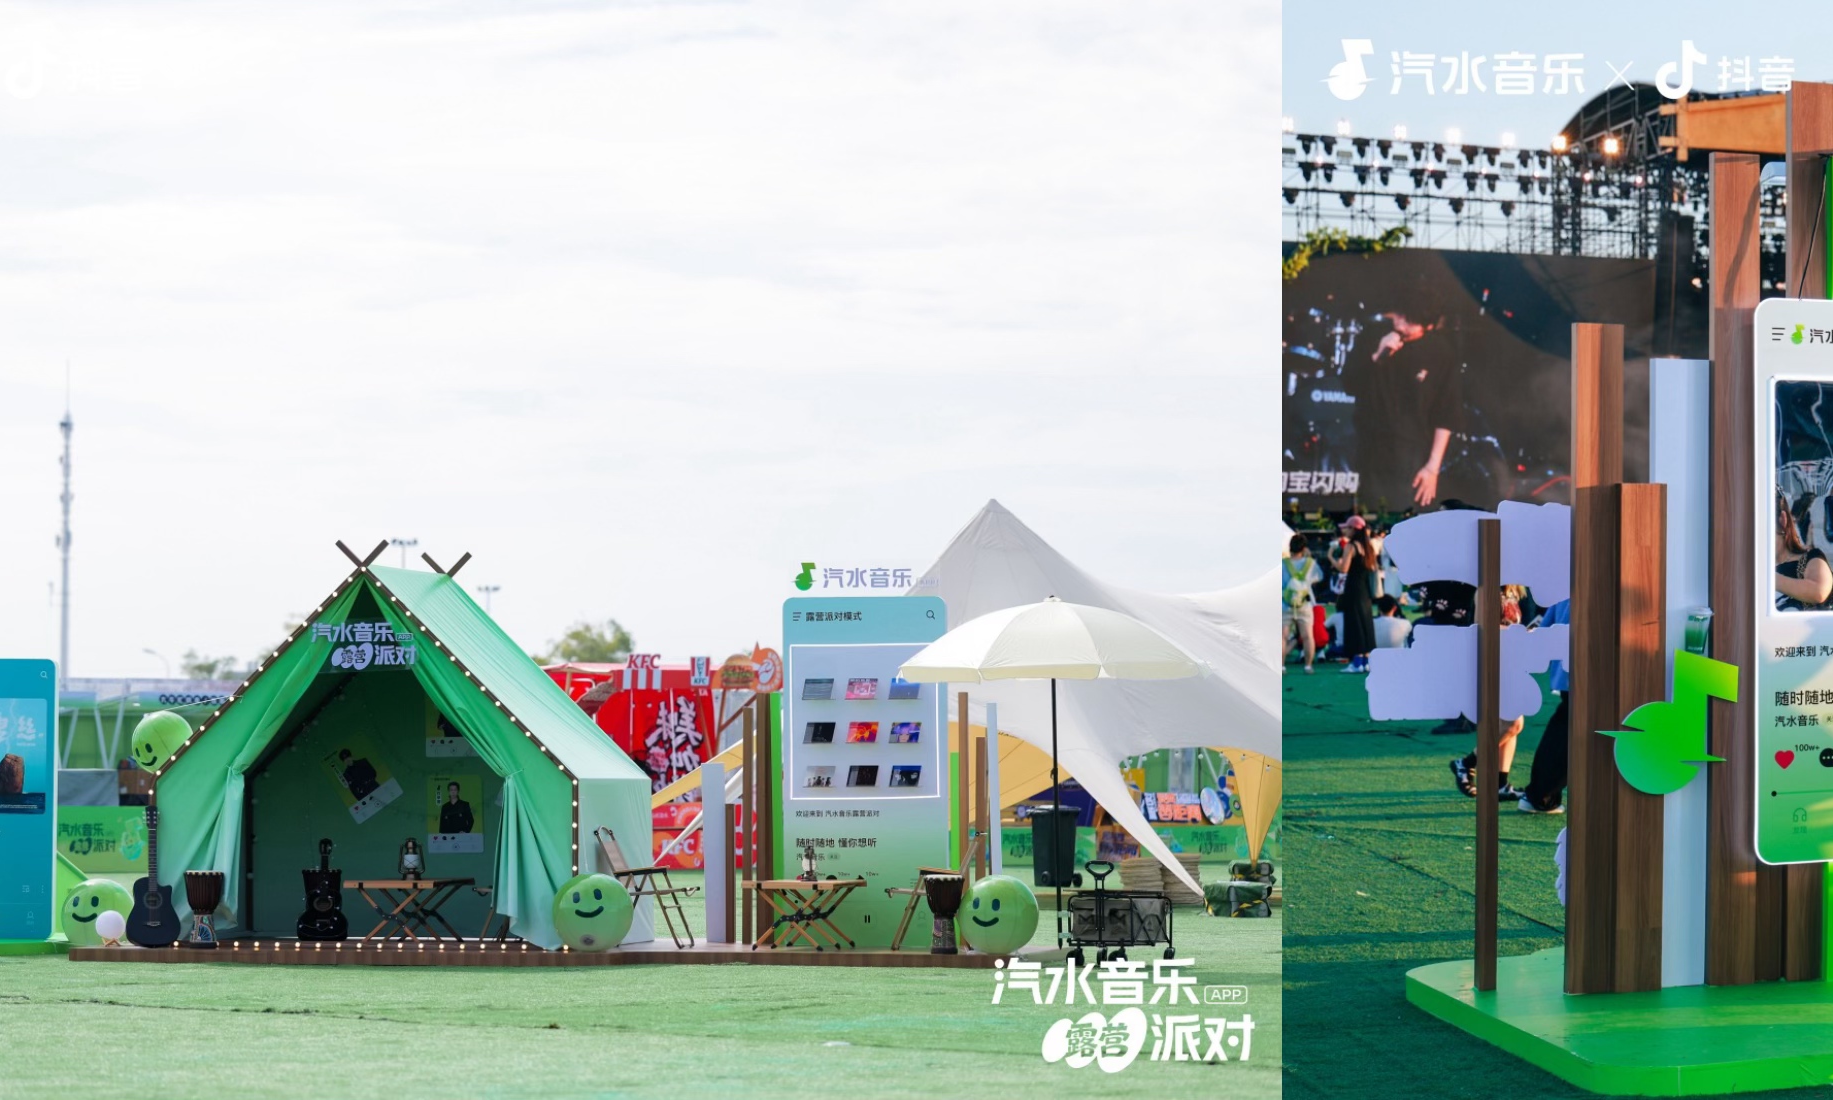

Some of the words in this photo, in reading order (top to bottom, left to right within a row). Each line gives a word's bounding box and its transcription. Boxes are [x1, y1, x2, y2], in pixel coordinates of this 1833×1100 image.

[823, 567, 912, 588] 汽水音乐
[805, 611, 862, 622] 露营派对模式
[311, 621, 394, 643] 汽水音乐
[1774, 646, 1816, 657] 欢迎来到
[627, 654, 661, 669] KFC
[1775, 690, 1833, 706] 随时随地
[1775, 714, 1819, 727] 汽水音乐
[1794, 744, 1820, 752] 100w+
[796, 838, 834, 848] 随时随地
[838, 838, 877, 848] 懂你想听
